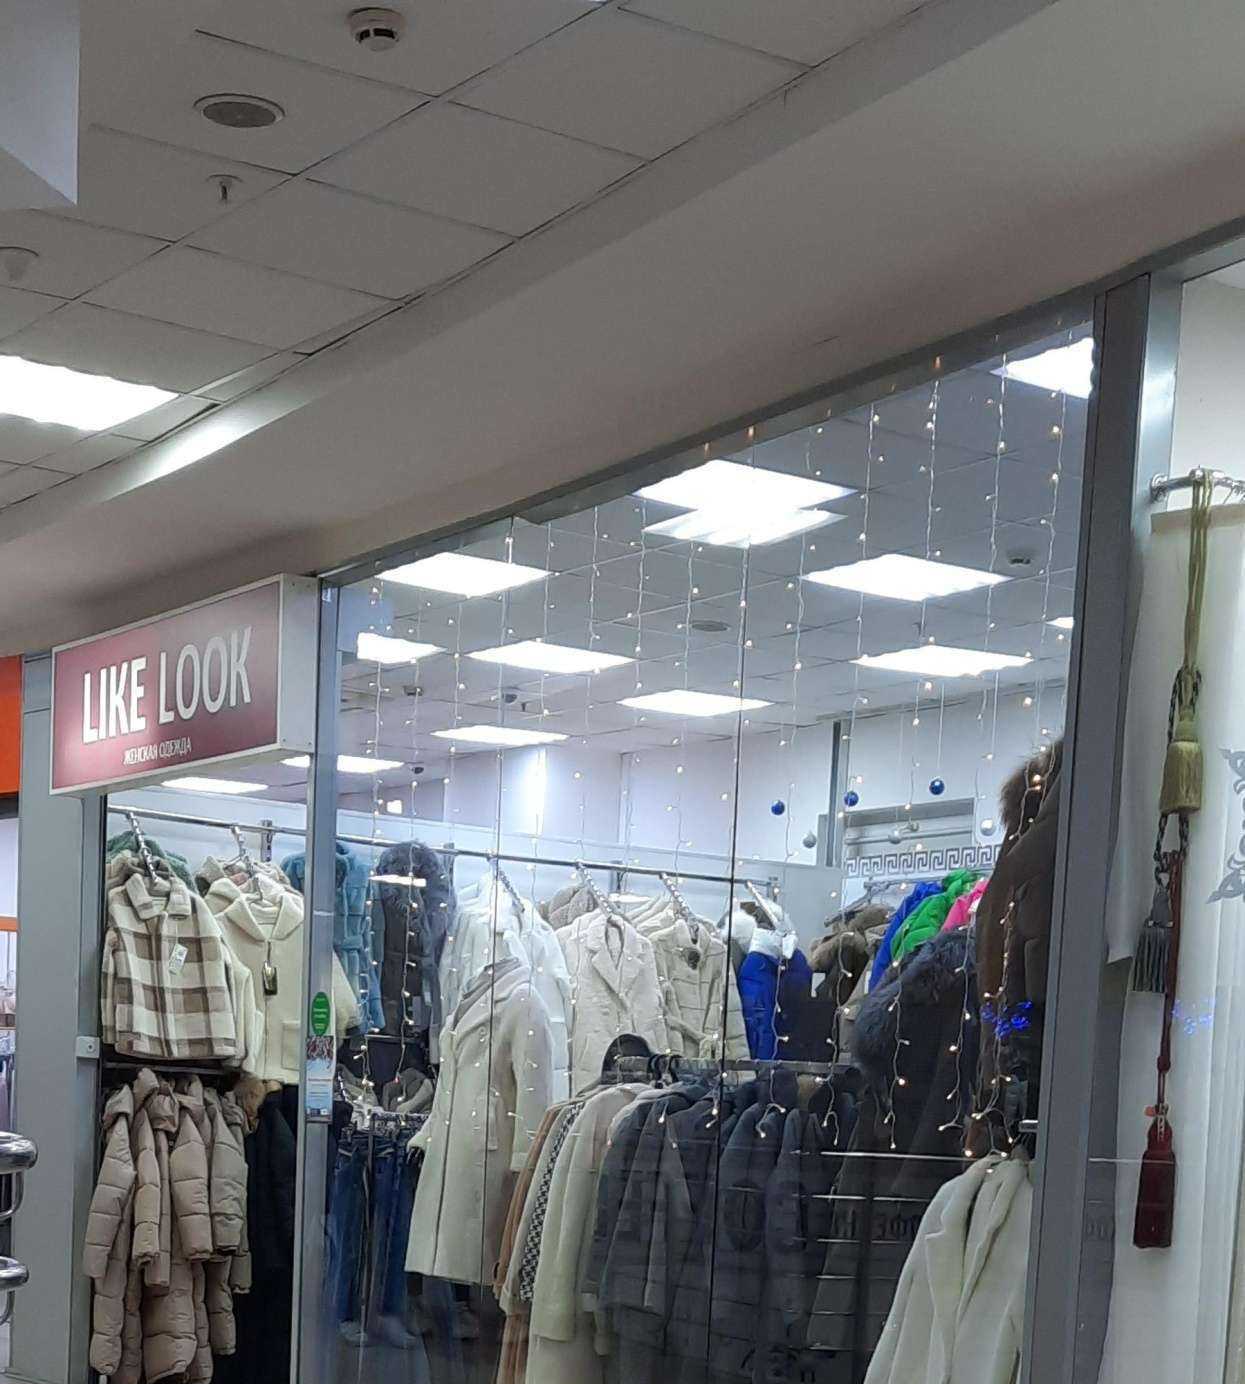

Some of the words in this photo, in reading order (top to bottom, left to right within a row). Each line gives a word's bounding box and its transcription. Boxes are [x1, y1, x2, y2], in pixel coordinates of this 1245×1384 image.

[83, 656, 147, 743] LIKE
[158, 626, 252, 724] LOOK
[123, 743, 158, 766] ЖЕНСКАЯ
[159, 736, 192, 757] ОДЕЖДА
